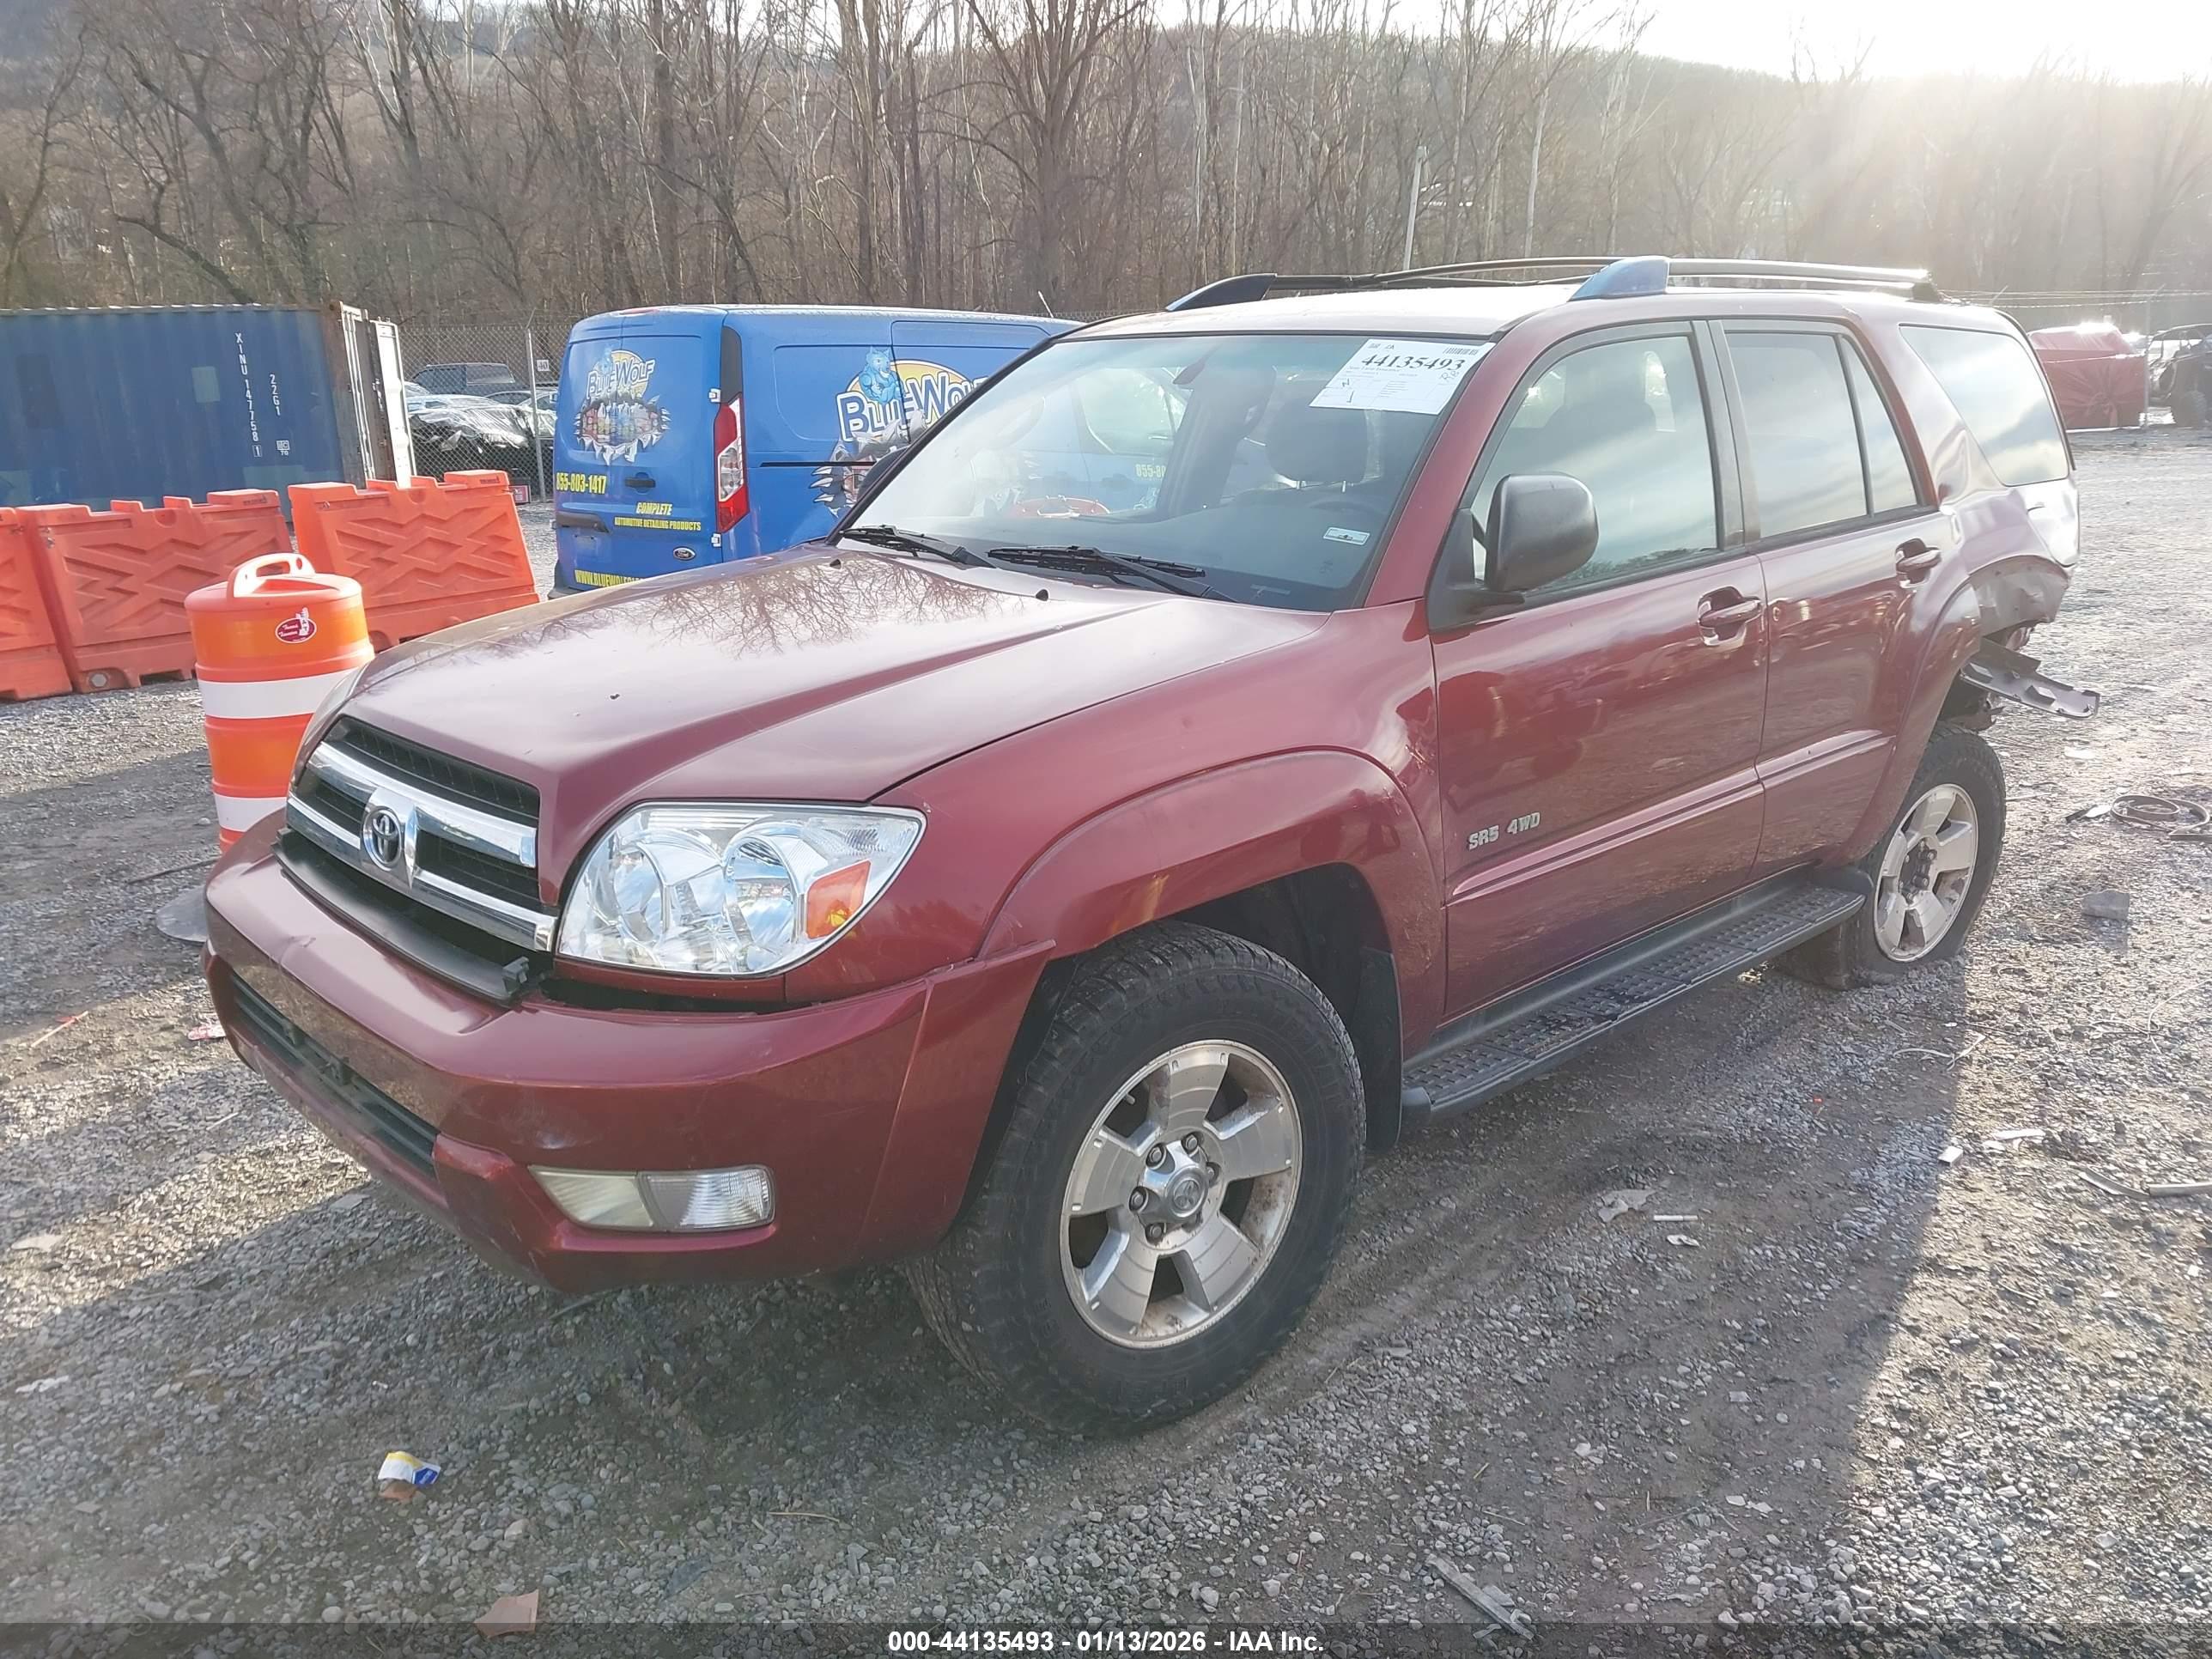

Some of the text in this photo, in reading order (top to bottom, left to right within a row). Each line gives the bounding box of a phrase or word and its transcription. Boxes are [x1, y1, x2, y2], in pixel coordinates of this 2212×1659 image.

[1361, 354, 1466, 371] 44135493
[234, 332, 248, 375] XINU
[246, 379, 258, 442] 147758
[270, 374, 281, 416] 22G1
[556, 472, 607, 495] 855-803-1417
[636, 502, 673, 515] COMPLETE
[670, 520, 702, 531] PRODUCTS
[1468, 812, 1540, 851] SR5 4WD
